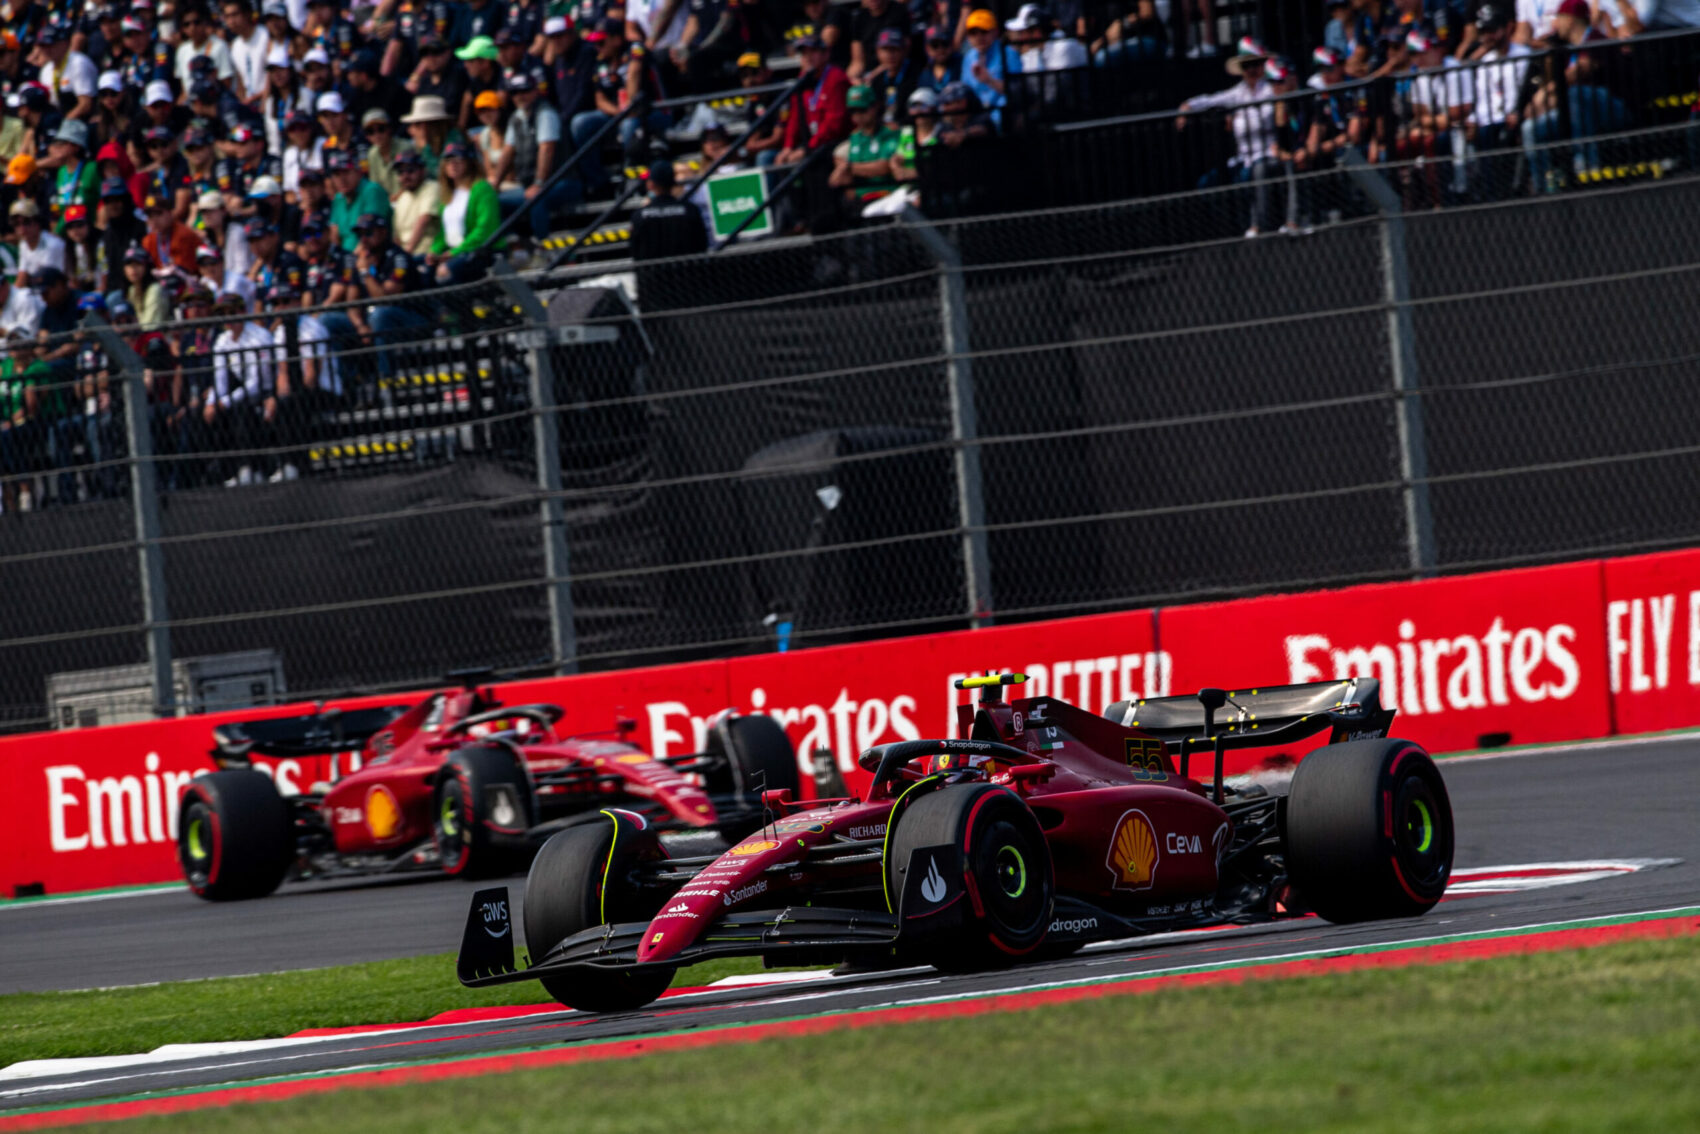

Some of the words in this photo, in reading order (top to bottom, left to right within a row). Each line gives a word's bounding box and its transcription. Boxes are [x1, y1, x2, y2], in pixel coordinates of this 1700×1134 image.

[1608, 594, 1676, 694] FLY
[1285, 617, 1580, 715] Emirates
[646, 687, 921, 776] Eates
[949, 741, 991, 750] Snapdragon
[1124, 738, 1169, 783] 55
[849, 823, 887, 839] RICHARD
[730, 880, 768, 904] Santander
[482, 900, 508, 923] aws
[653, 911, 700, 920] antander
[1047, 917, 1098, 933] dragon
